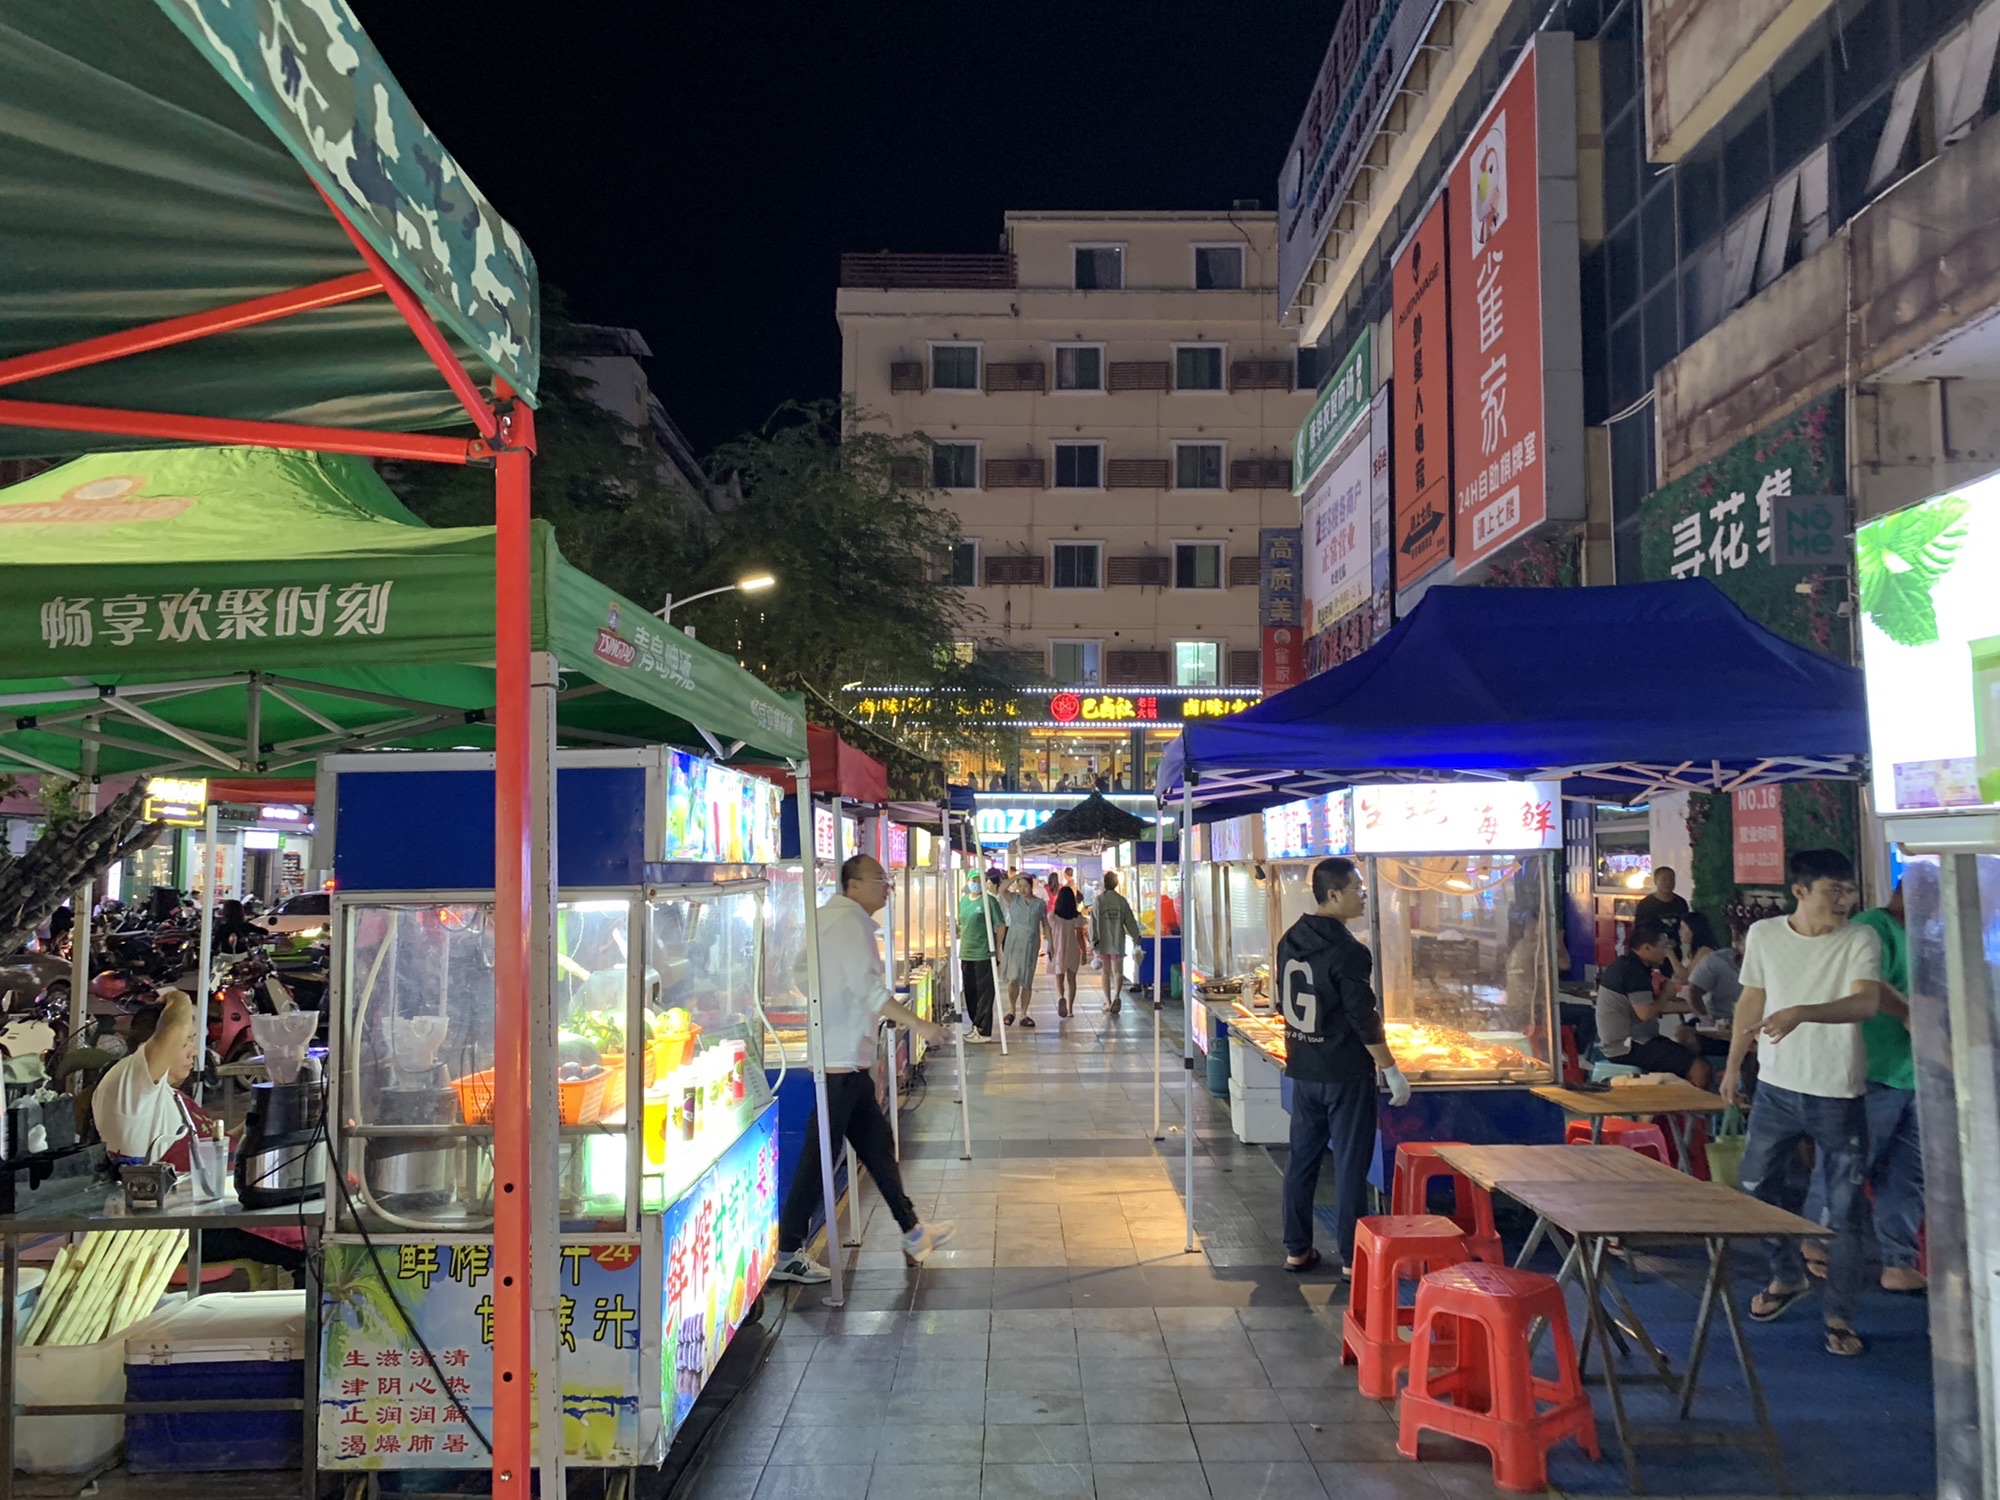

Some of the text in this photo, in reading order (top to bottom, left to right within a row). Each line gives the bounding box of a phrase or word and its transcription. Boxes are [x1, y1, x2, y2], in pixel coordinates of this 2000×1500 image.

[1398, 262, 1439, 328] ALIENWARE
[1476, 249, 1508, 457] 雀家
[1458, 431, 1536, 515] 24H自助棋牌室
[40, 581, 393, 649] 畅享欢聚时刻
[599, 632, 636, 663] TSINGTAO
[634, 626, 696, 691] 青岛啤酒
[1738, 788, 1776, 811] NO.16
[1738, 825, 1777, 843] 营业时间
[1283, 958, 1316, 1033] G
[399, 1244, 592, 1288] 鲜榨汁
